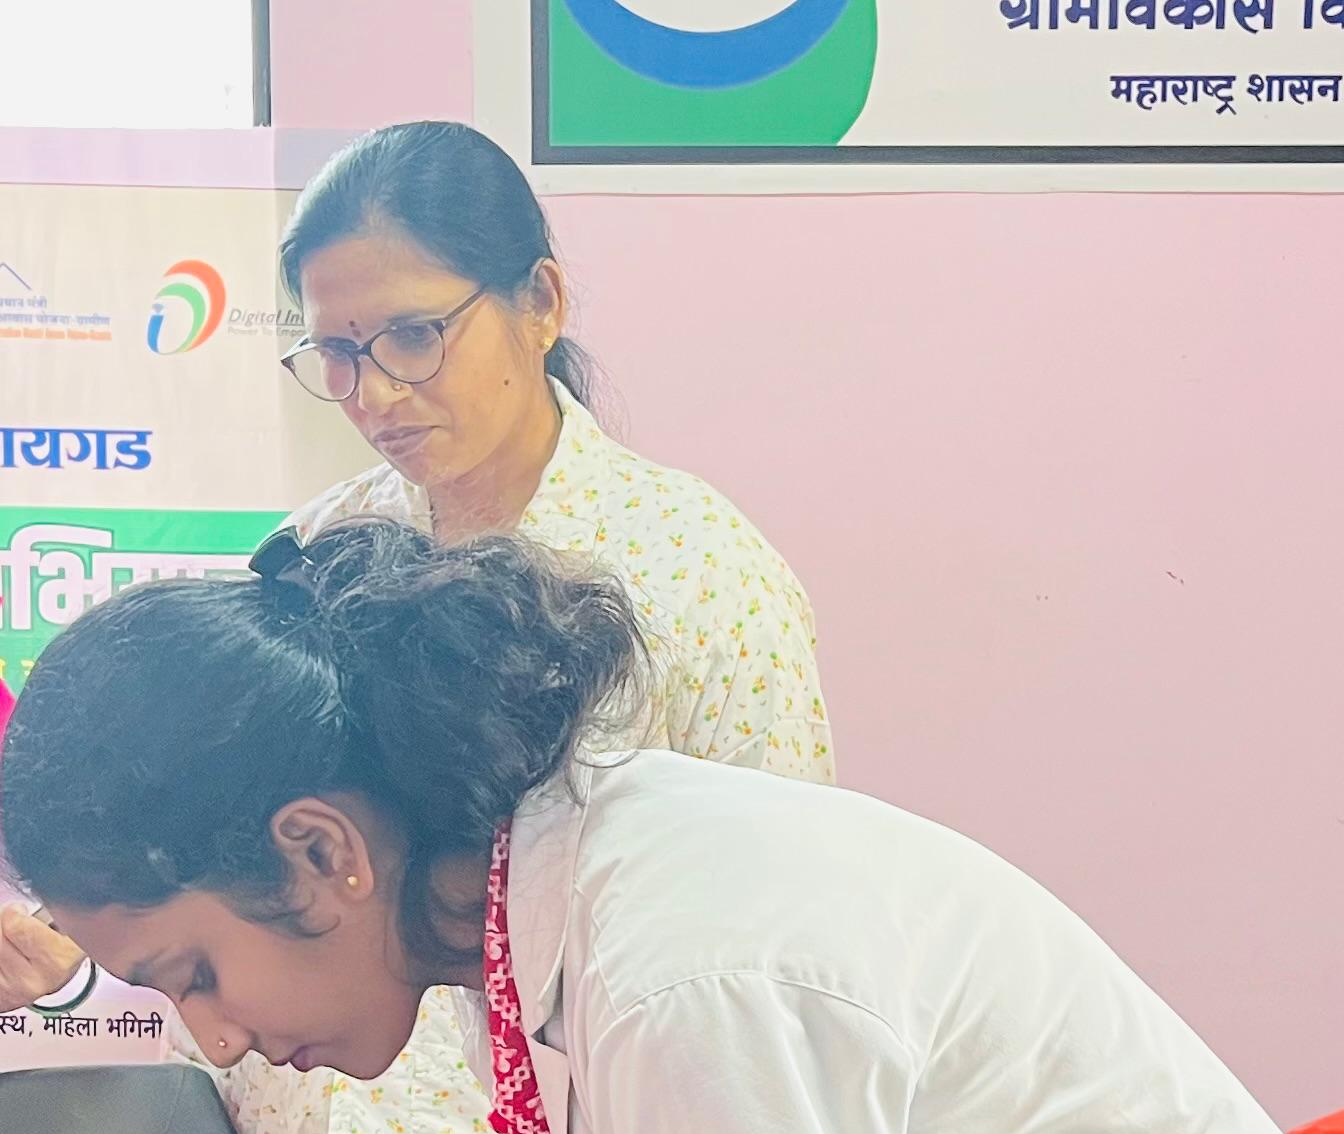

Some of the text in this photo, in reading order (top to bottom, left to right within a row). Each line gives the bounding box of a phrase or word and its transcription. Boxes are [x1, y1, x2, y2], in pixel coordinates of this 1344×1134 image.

[1111, 73, 1343, 115] महाराष्ट्र शासन
[229, 308, 281, 326] Digital
[106, 1011, 163, 1038] भगिनी
